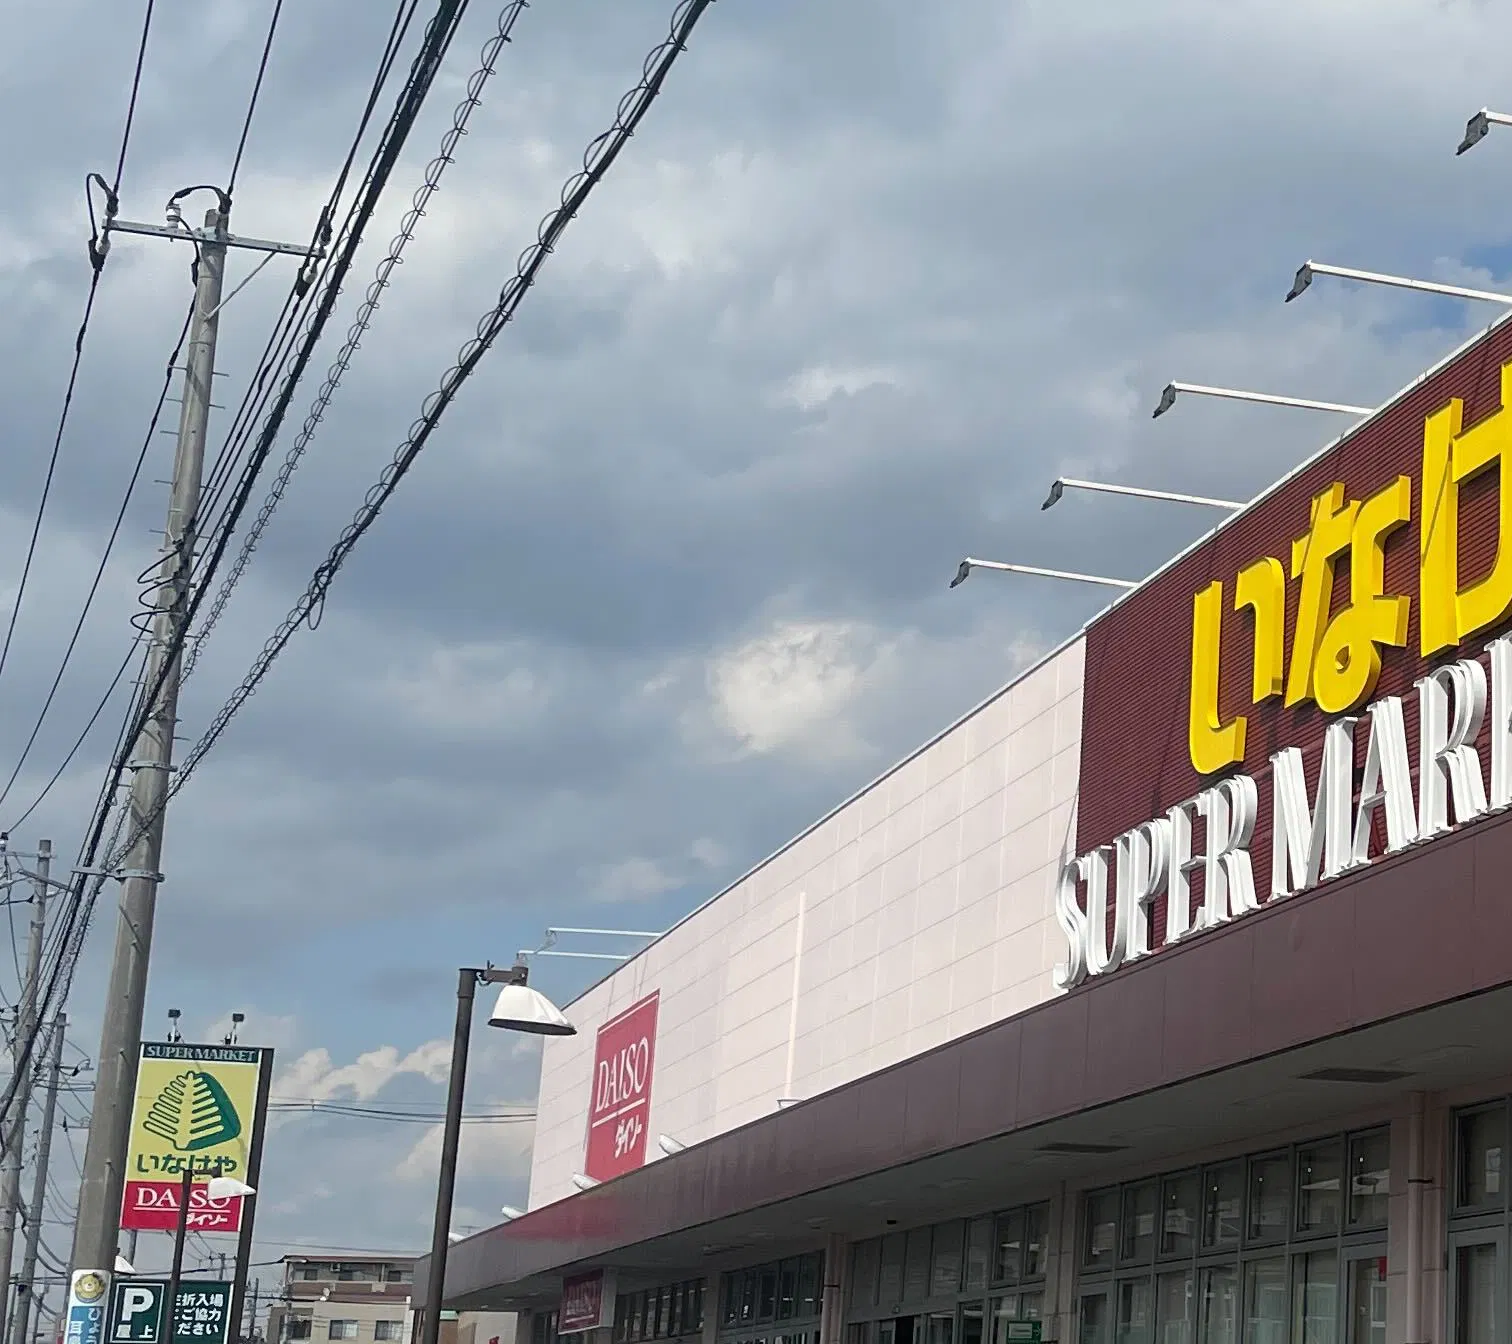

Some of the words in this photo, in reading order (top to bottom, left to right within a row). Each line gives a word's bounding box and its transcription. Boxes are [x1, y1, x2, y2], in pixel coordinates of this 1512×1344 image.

[1053, 774, 1262, 993] SUPER
[147, 1045, 193, 1059] SUPER
[195, 1047, 255, 1062] MARKET
[595, 1036, 649, 1114] DAISO
[121, 1287, 154, 1321] P
